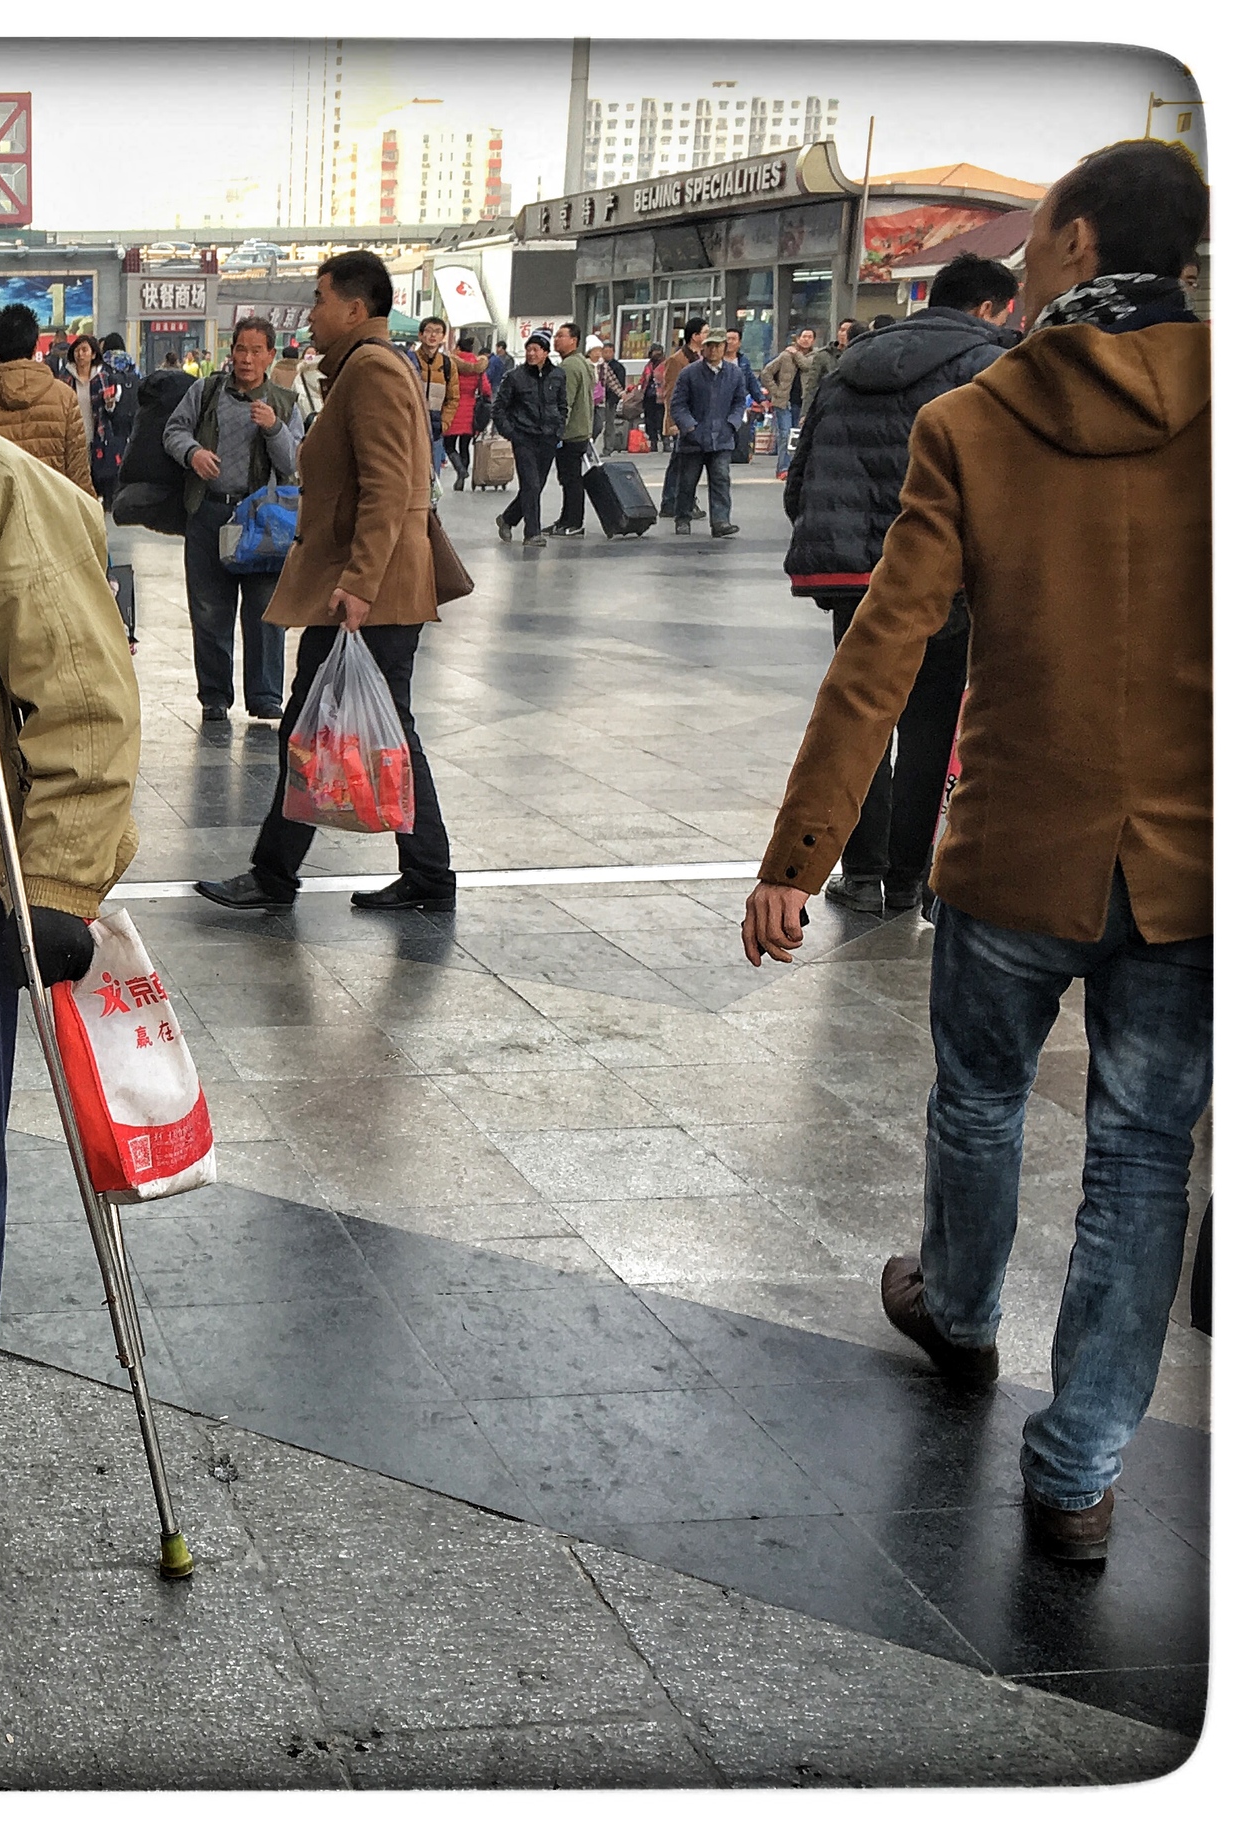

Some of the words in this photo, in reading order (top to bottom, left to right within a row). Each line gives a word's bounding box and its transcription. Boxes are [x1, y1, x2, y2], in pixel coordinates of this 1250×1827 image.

[633, 181, 681, 212] BEIJING
[684, 160, 784, 202] SPECIALITIES
[537, 192, 618, 233] 北京特产
[142, 283, 206, 309] 快餐商场
